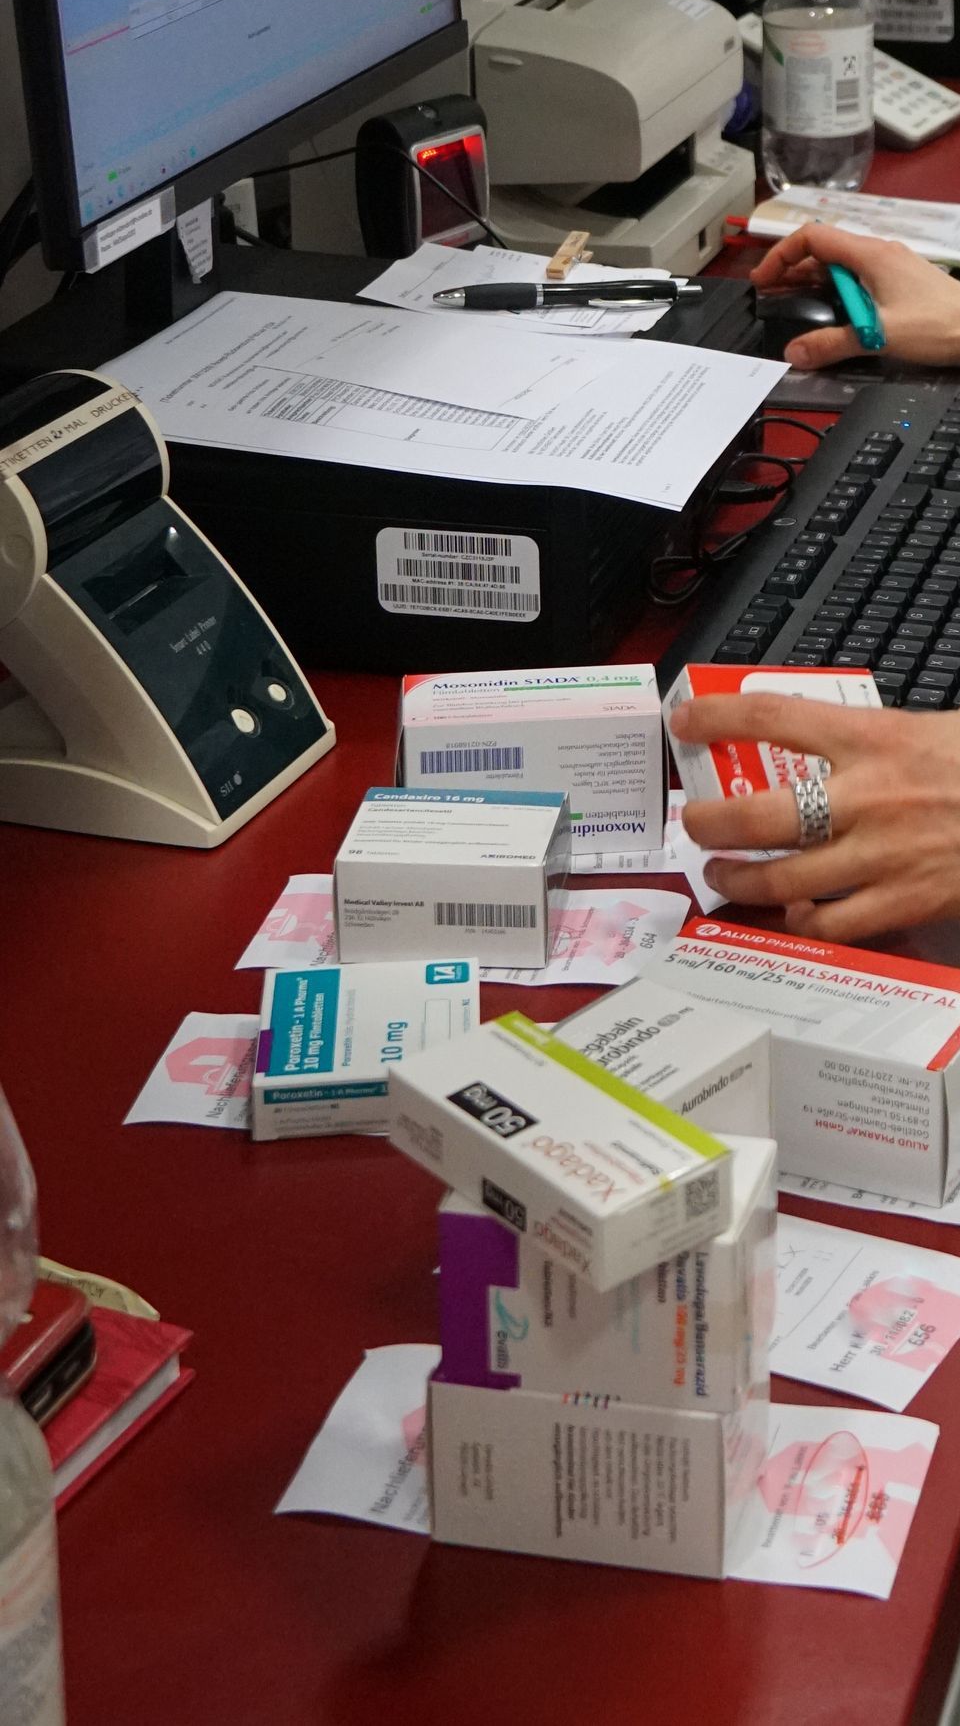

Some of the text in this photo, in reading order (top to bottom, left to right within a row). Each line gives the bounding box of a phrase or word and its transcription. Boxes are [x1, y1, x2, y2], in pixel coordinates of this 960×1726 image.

[63, 418, 88, 434] MAL
[432, 678, 519, 691] Moxonidin
[609, 674, 640, 685] mg
[374, 792, 486, 804] Candaxiro 16 mg
[585, 809, 646, 820] Filmtabletten
[344, 898, 370, 906] Medical
[371, 899, 392, 907] Valley
[719, 928, 767, 945] ALIUD
[664, 952, 892, 1009] 5 mg/160 mg/25 mg Filmtabletten
[675, 941, 958, 1010] AMLODIPIN/VALSARTAN/HCT AL
[303, 992, 325, 1070] 10 mg Filmtabletten
[381, 1021, 409, 1064] 10 mg
[580, 1015, 645, 1059] egabalin
[283, 1022, 304, 1072] Paroxetin
[272, 1089, 324, 1101] Paroxetin
[680, 1074, 729, 1116] Aurobindo
[817, 1070, 930, 1103] Verschreibungspflichtig
[836, 1099, 930, 1128] D-89150 Laichingen
[871, 1095, 930, 1116] Filmtablette
[803, 1103, 930, 1140] Gottlieb-Daimler-Straße 19
[815, 1119, 845, 1133] GmbH
[898, 1137, 930, 1152] ALIUD
[908, 1322, 938, 1349] 656
[829, 1348, 855, 1373] Herr
